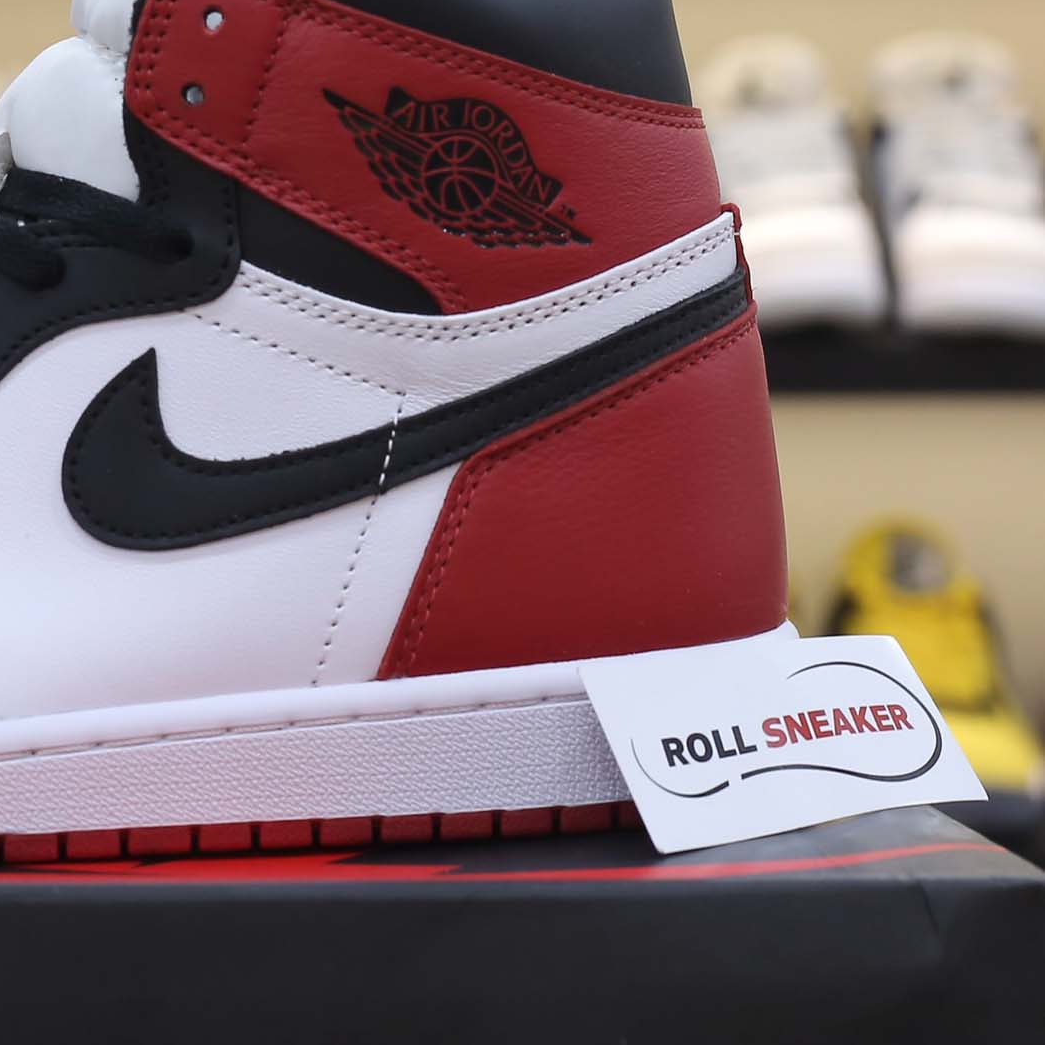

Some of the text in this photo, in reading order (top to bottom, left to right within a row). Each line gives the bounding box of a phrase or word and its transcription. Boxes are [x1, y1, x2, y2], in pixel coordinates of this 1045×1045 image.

[392, 100, 552, 202] AIR JORDAN
[661, 703, 914, 767] ROLL SNEAKER
